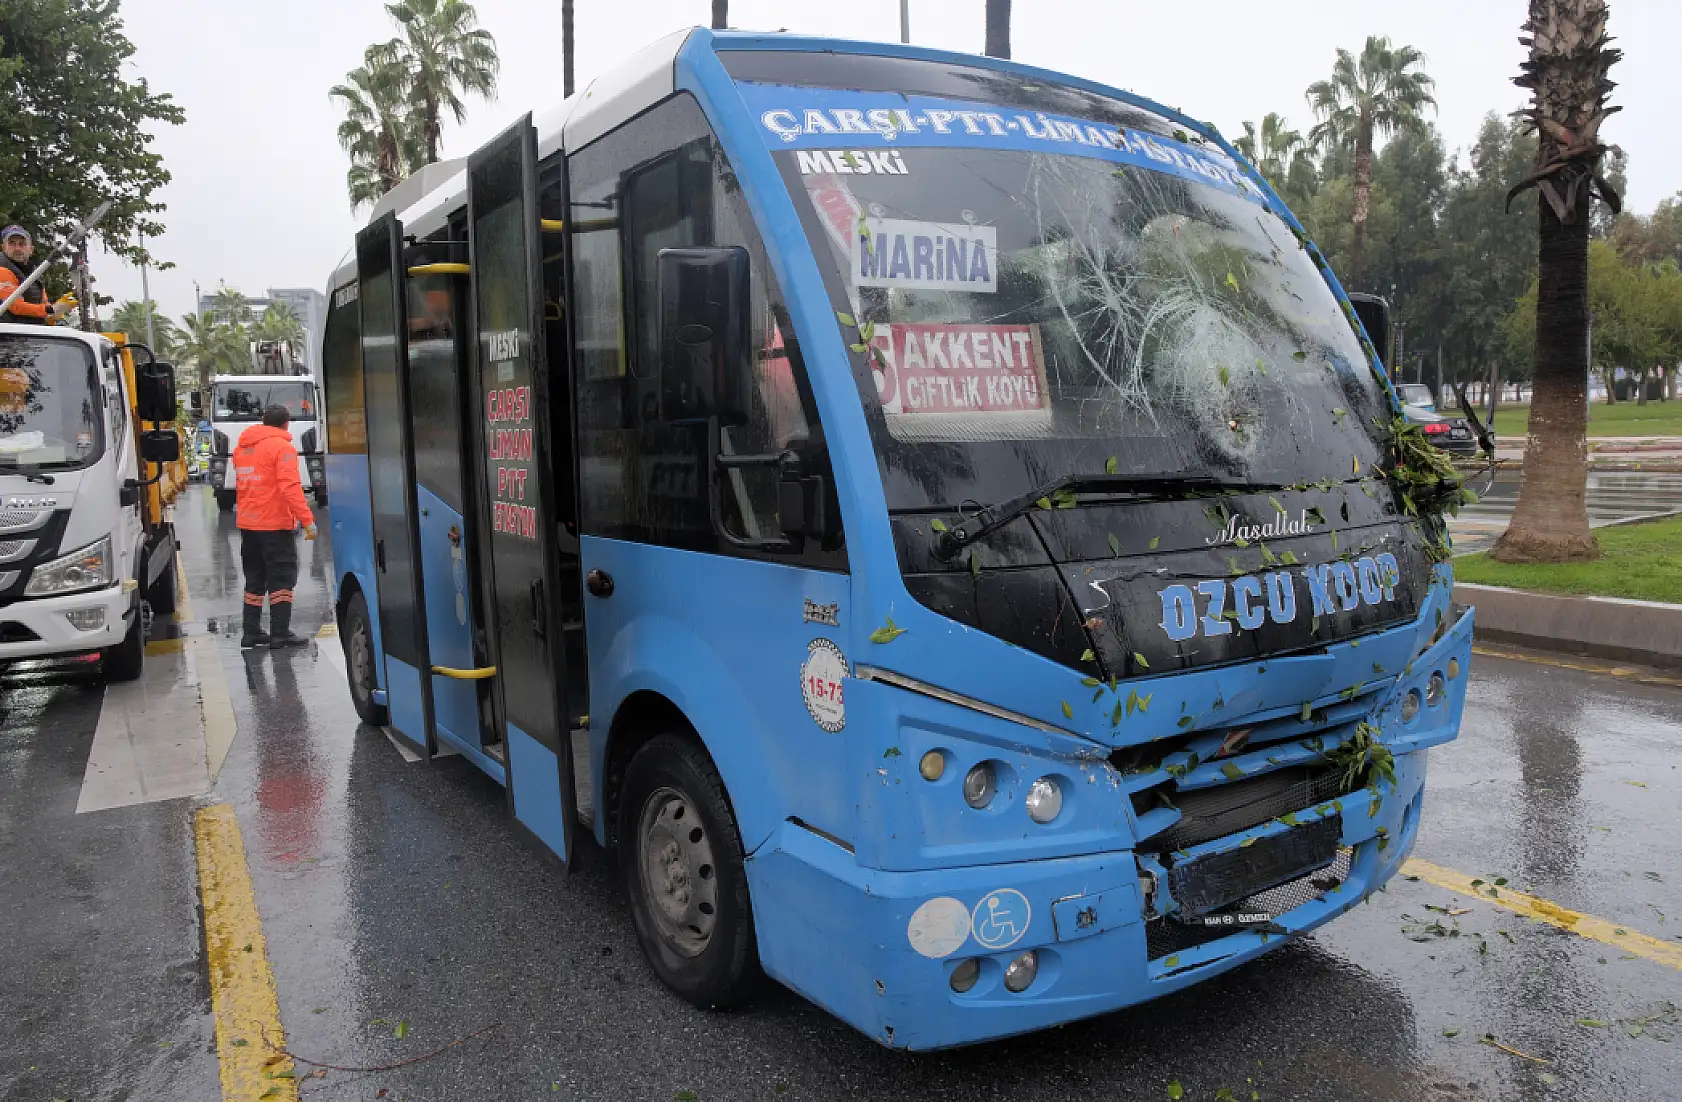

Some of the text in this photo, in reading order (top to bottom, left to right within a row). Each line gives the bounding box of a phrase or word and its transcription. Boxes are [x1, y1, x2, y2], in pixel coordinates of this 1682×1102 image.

[903, 331, 1031, 369] AKKENT
[497, 467, 528, 501] PTT
[1301, 552, 1400, 618] KOOP
